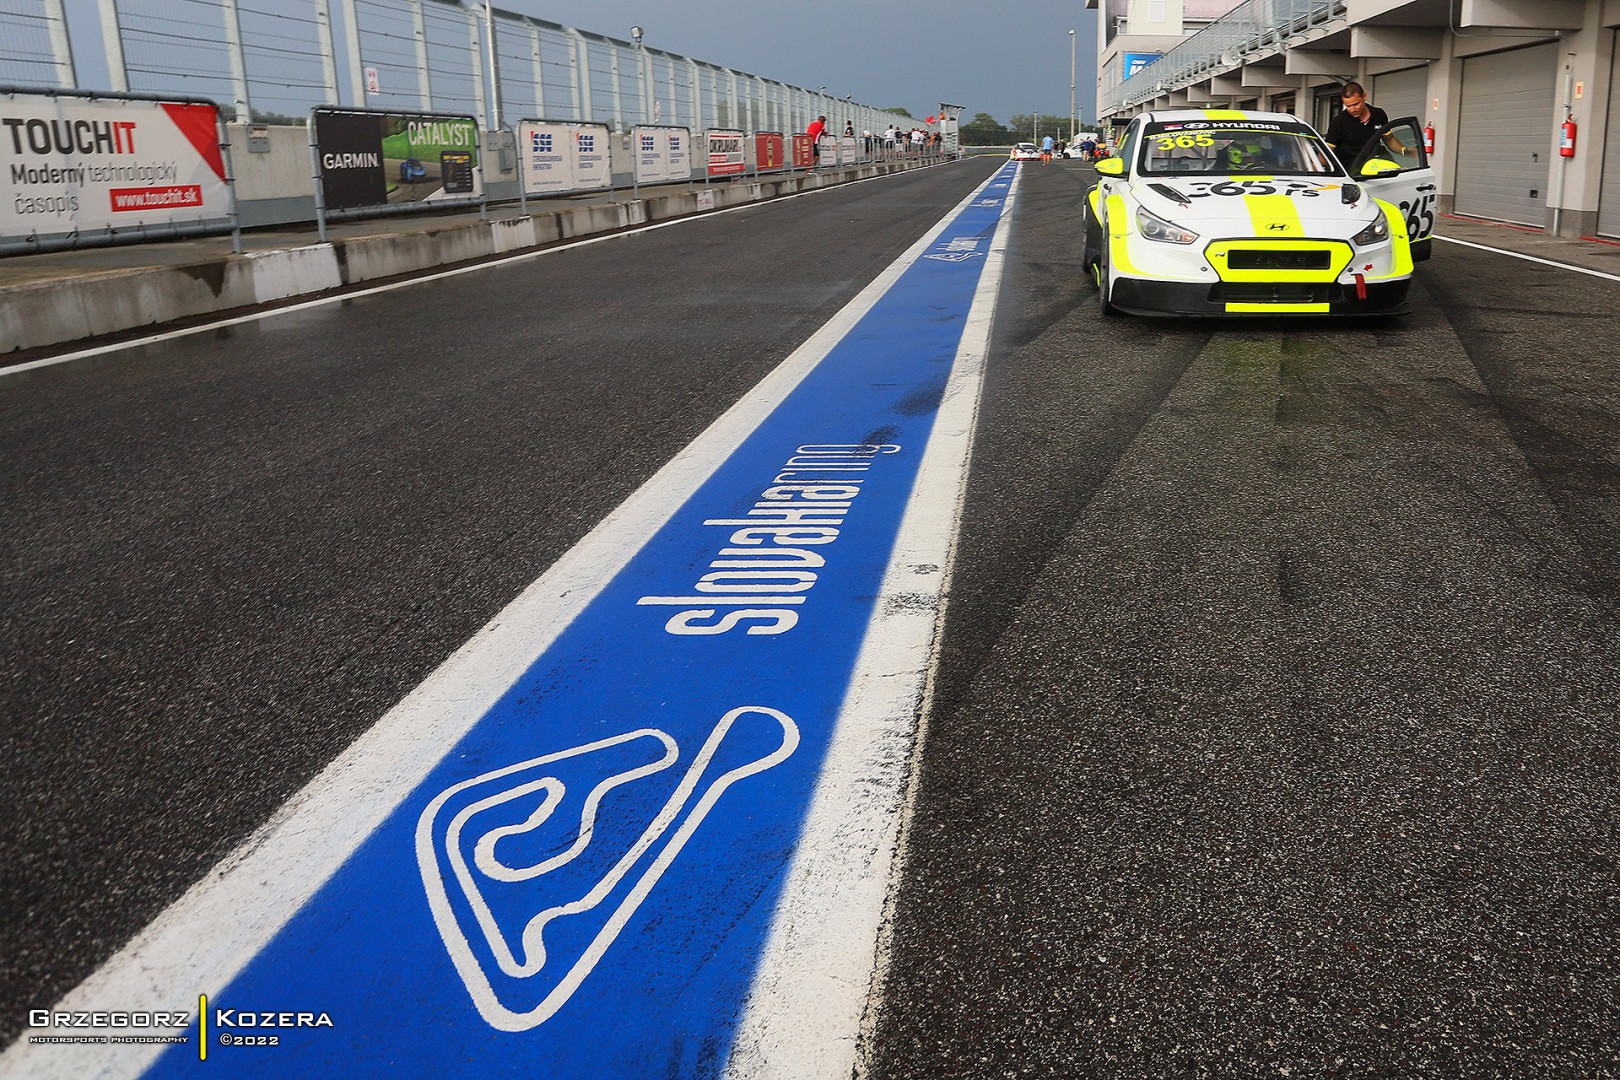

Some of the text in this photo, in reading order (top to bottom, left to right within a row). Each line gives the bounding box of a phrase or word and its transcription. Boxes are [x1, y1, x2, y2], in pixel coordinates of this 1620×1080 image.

[2, 118, 136, 154] TOUCHIT
[407, 121, 471, 146] CATALYST
[1213, 122, 1281, 131] HYUNDAI
[1156, 133, 1215, 151] 365
[323, 153, 378, 169] GARMIN
[10, 160, 178, 188] Moderný technologický
[15, 191, 80, 217] časopis
[115, 187, 198, 208] www.touchit.sk
[636, 444, 902, 635] slovakiaring
